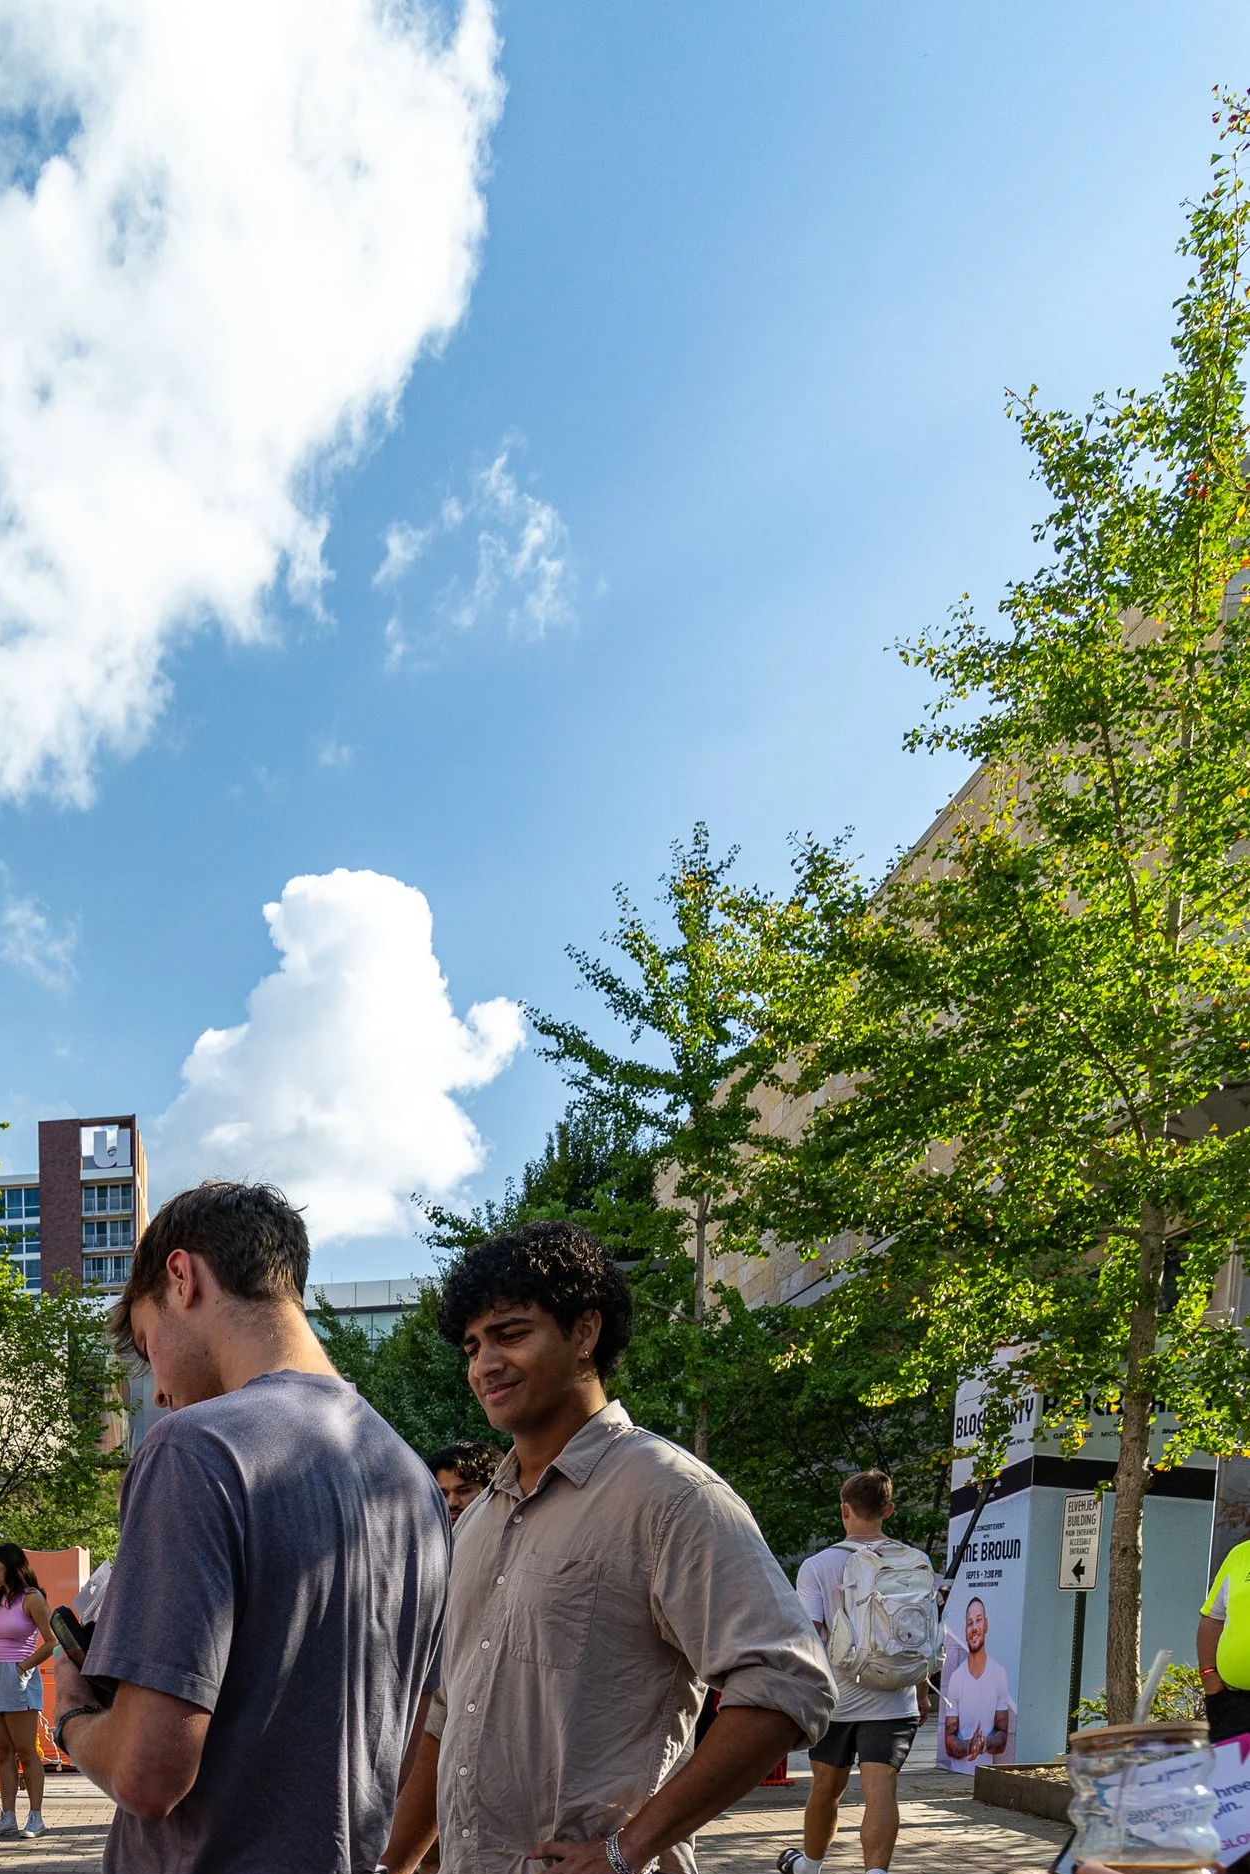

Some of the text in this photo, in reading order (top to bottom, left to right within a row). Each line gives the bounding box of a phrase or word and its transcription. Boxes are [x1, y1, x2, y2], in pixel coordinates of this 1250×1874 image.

[1053, 1431, 1094, 1440] GATDE
[1161, 1427, 1181, 1435] Shar
[1068, 1499, 1098, 1513] ELVEHJEM
[1067, 1513, 1097, 1527] BUILDING
[1065, 1528, 1097, 1537] MAIN ENTRANCE
[1069, 1537, 1092, 1546] ACCESSIBLE
[981, 1539, 1021, 1561] BROWN
[1069, 1546, 1090, 1555] ENTRANCE
[1213, 1780, 1250, 1799] hree
